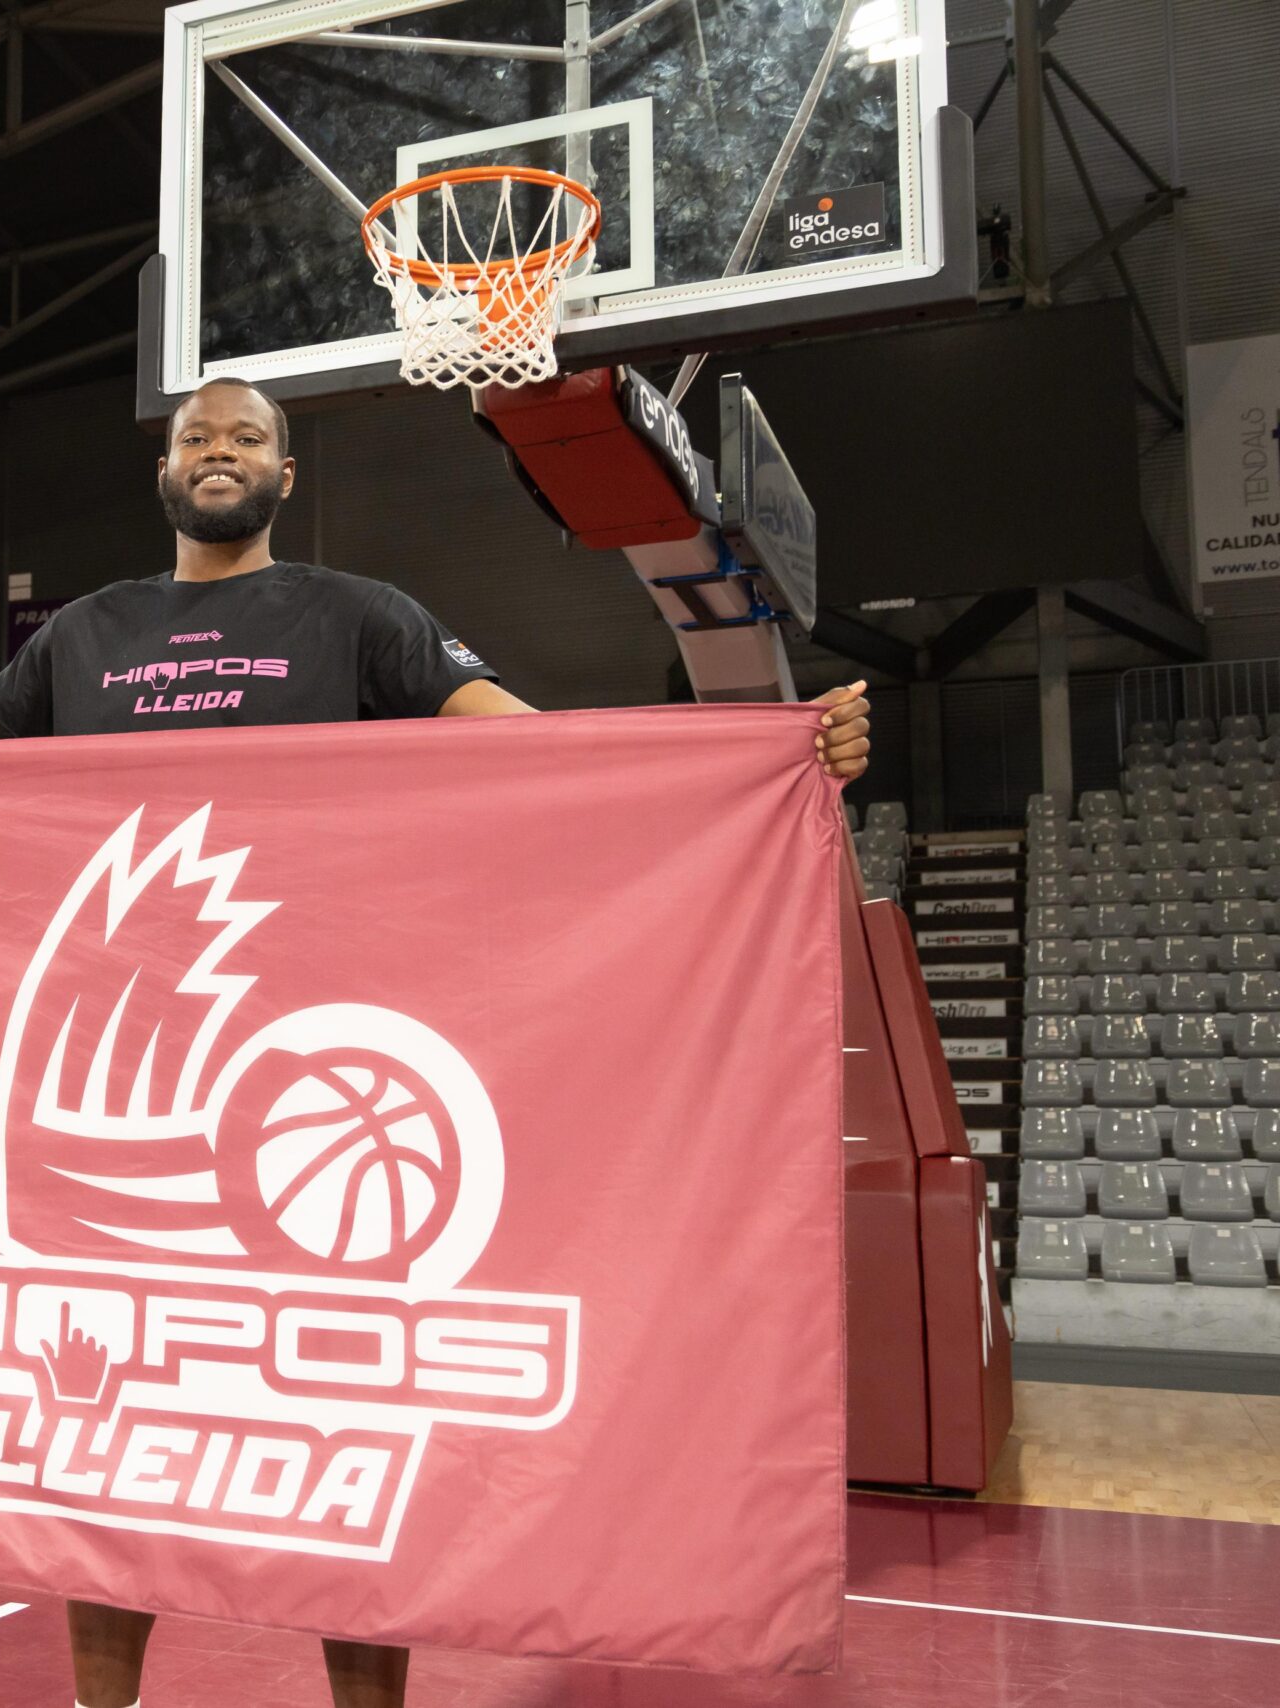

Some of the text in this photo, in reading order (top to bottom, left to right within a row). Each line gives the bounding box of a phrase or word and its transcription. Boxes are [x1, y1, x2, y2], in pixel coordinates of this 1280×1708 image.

[789, 212, 829, 232] liga
[789, 222, 879, 249] endesa
[1241, 407, 1269, 507] TENDALS
[102, 658, 289, 689] HIOPOS
[133, 691, 244, 713] LLEIDA
